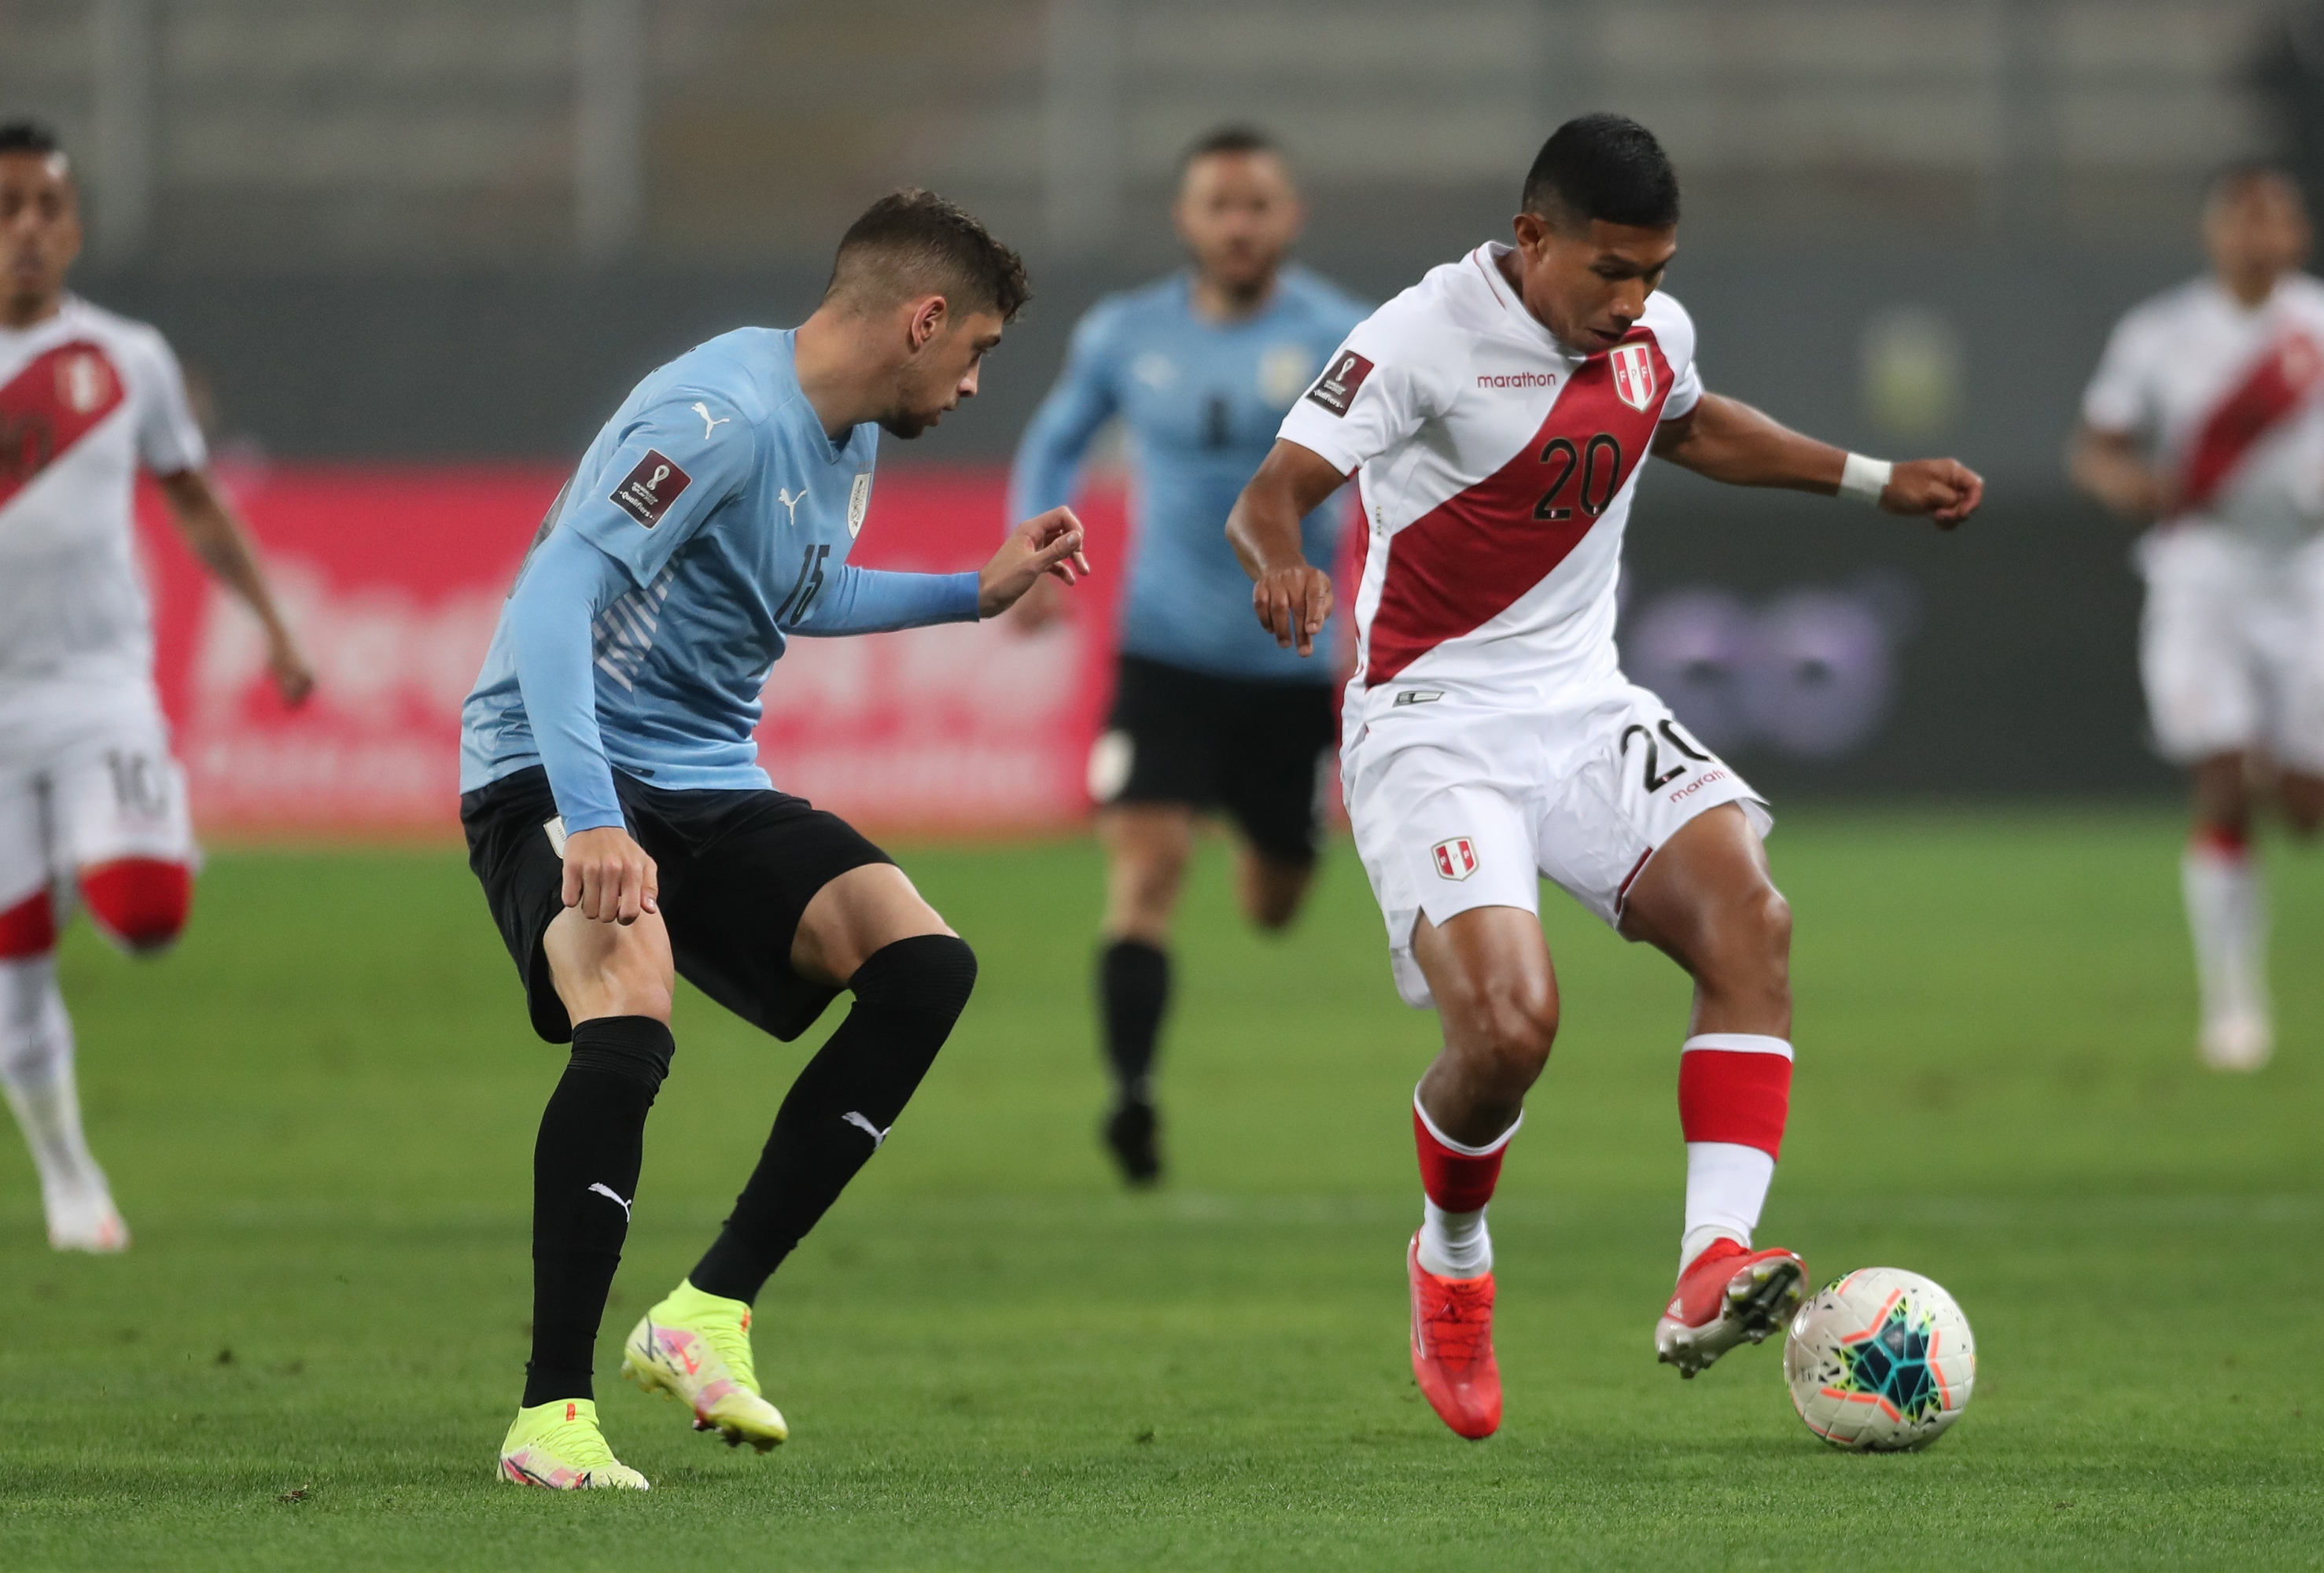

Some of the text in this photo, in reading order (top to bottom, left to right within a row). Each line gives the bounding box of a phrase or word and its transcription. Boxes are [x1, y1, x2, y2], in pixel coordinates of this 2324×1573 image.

[1477, 372, 1556, 389] marathon
[621, 491, 650, 517] Qualifiers
[1533, 433, 1621, 521] 20
[773, 544, 831, 627] 15
